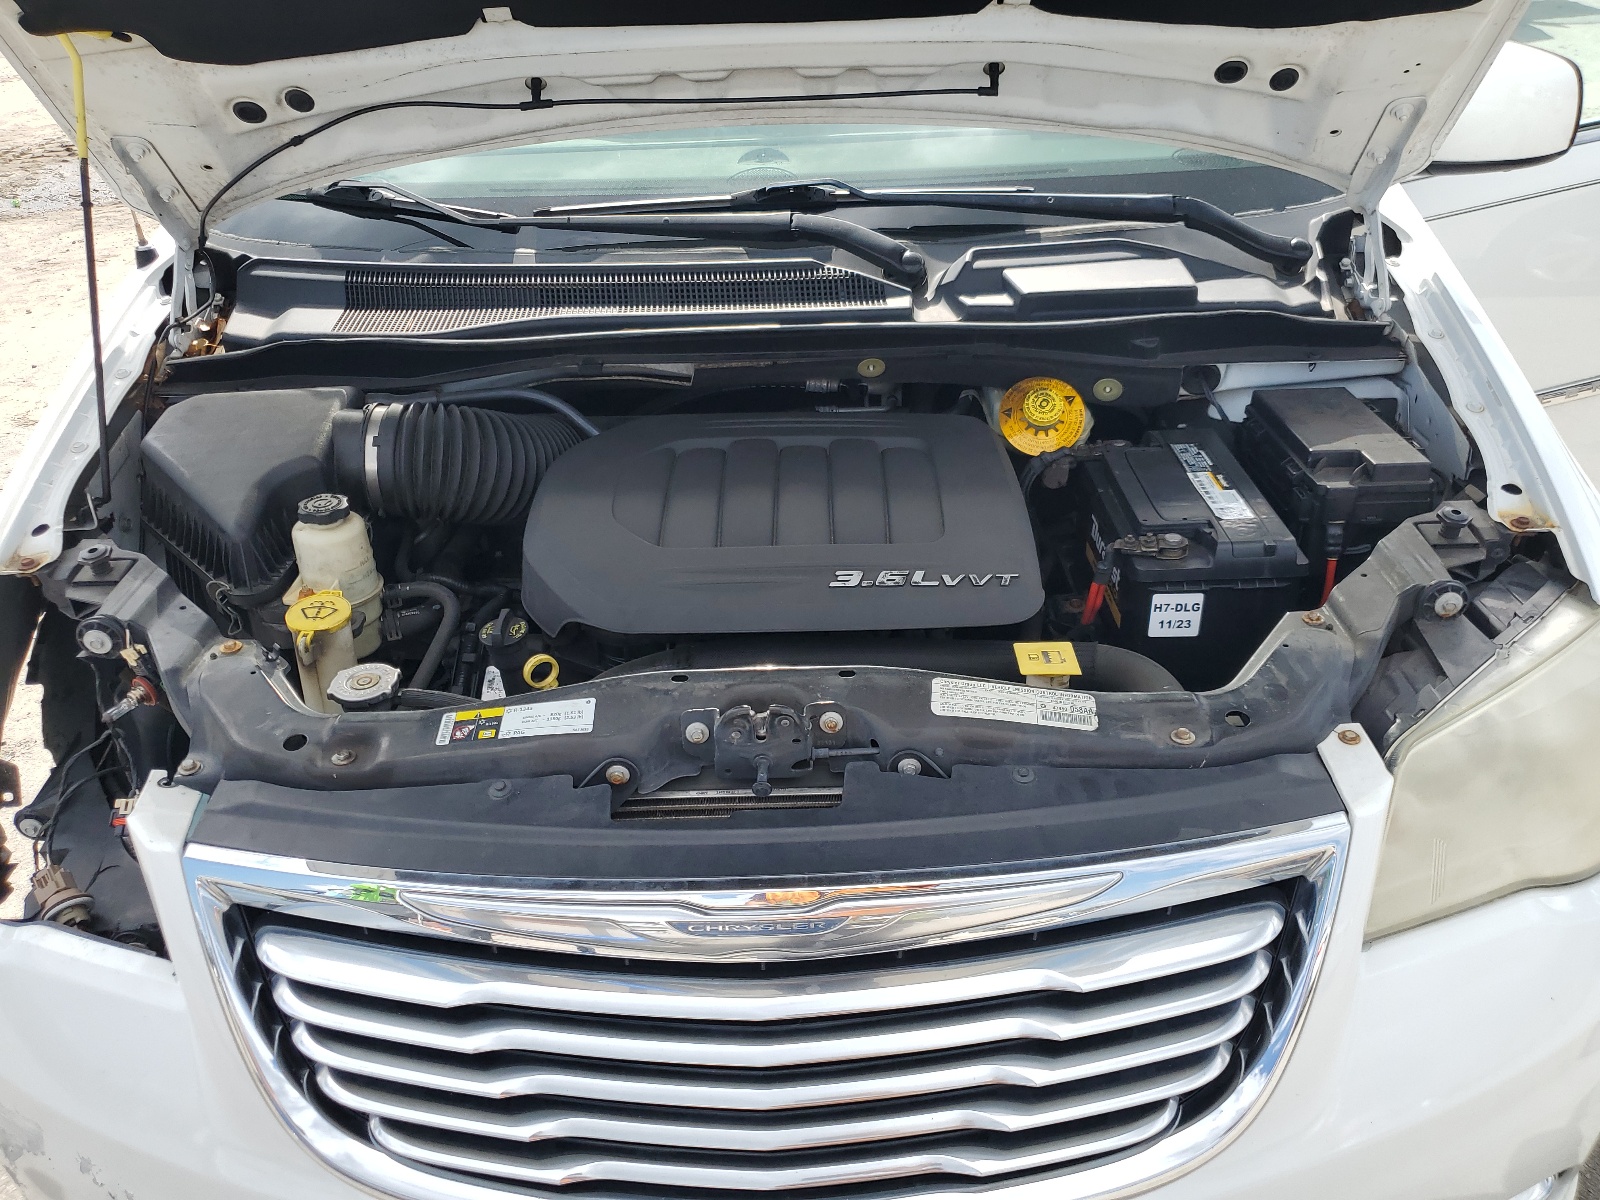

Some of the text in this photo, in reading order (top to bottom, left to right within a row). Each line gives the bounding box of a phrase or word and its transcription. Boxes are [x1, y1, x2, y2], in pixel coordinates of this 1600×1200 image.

[828, 570, 1020, 587] 3.6L VVT
[1153, 602, 1201, 613] H7-DLG
[1158, 619, 1192, 629] 11/23
[688, 921, 826, 932] CHRYSLER
